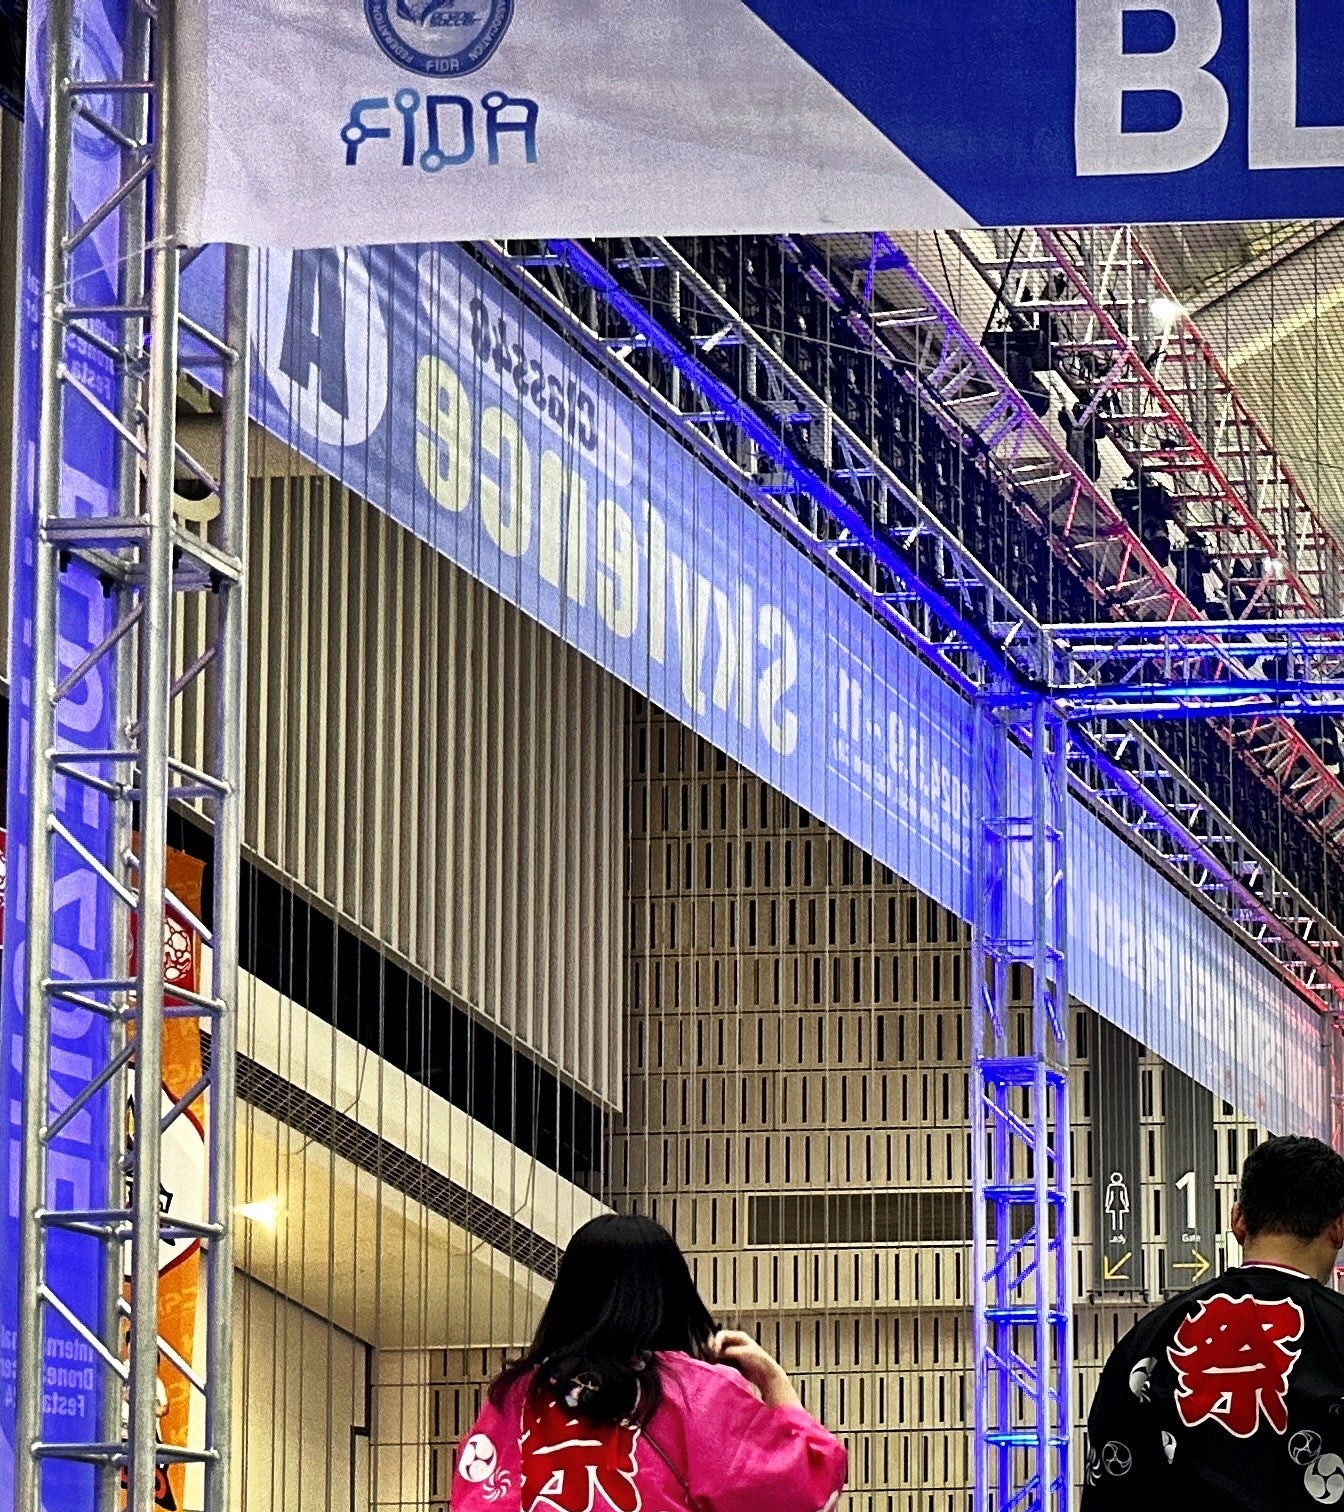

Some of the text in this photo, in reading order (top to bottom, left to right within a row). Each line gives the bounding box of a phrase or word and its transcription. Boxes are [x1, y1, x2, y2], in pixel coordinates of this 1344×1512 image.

[425, 59, 460, 72] FIDA
[1175, 1171, 1196, 1229] 1
[1166, 1293, 1305, 1438] 祭
